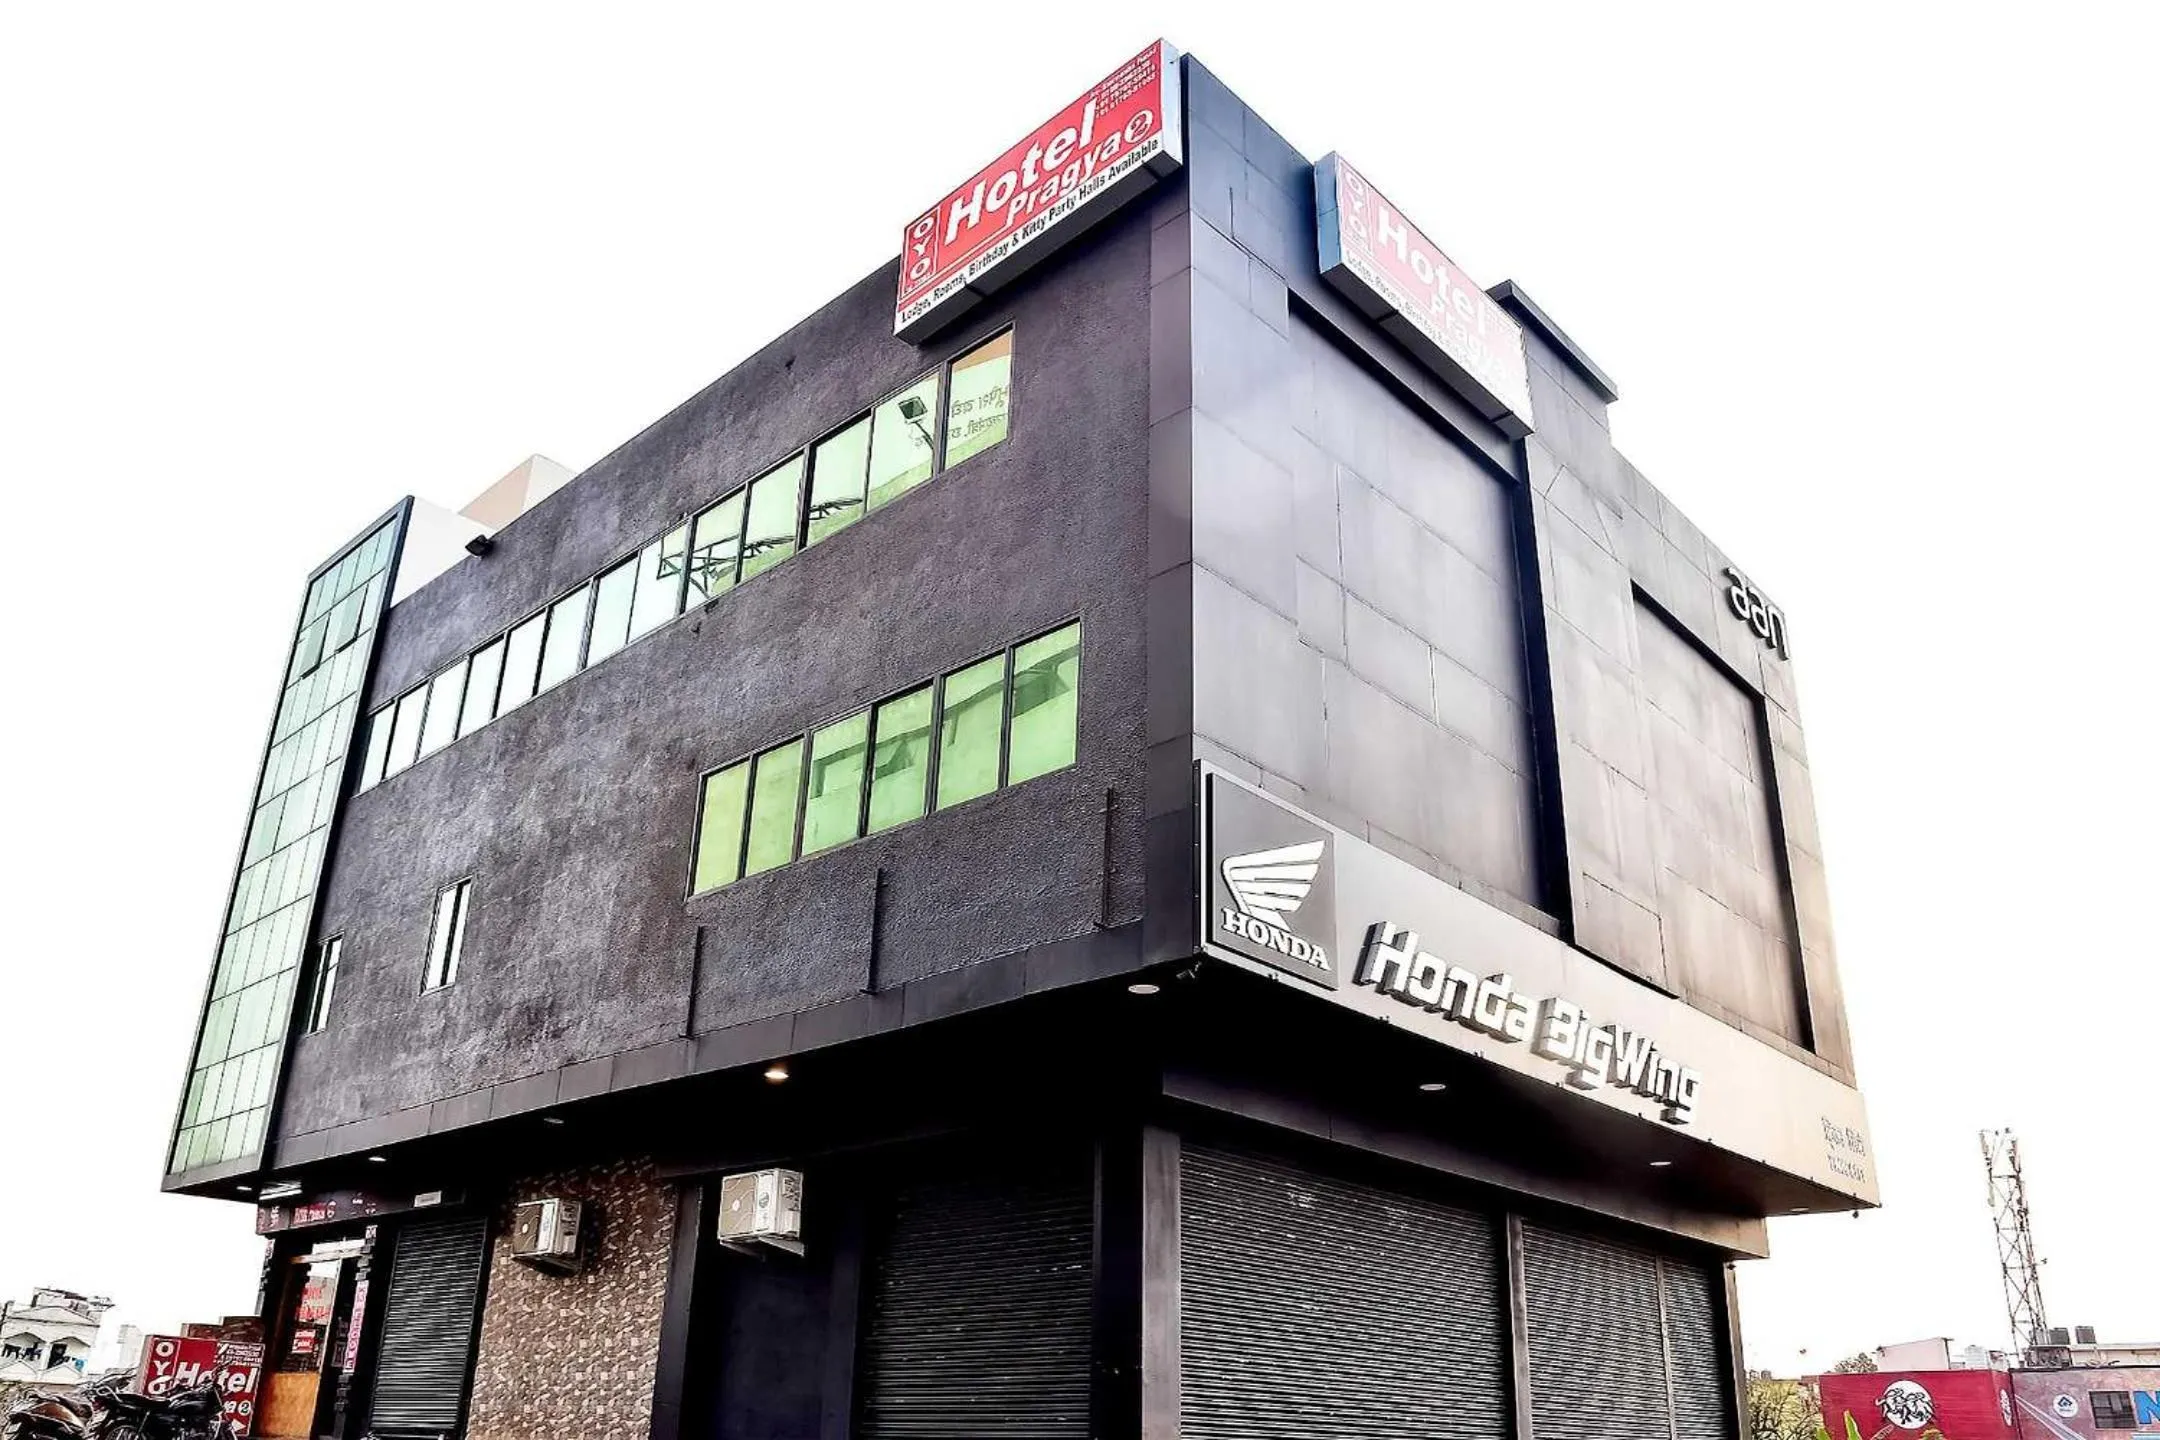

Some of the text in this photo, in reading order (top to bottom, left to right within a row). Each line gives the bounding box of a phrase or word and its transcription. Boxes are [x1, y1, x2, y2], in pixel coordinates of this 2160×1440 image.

[944, 97, 1097, 246] Hotel
[969, 242, 1009, 276] Birthday
[1021, 216, 1046, 239] Kitty
[1049, 195, 1076, 221] Party
[1080, 176, 1105, 200] Halls
[1108, 139, 1159, 181] Available
[1005, 112, 1150, 228] Pragya 2
[910, 217, 934, 280] OYO
[1378, 205, 1487, 336] Hotel
[1221, 907, 1332, 971] HONDA
[1354, 920, 1704, 1124] Honda BigWing
